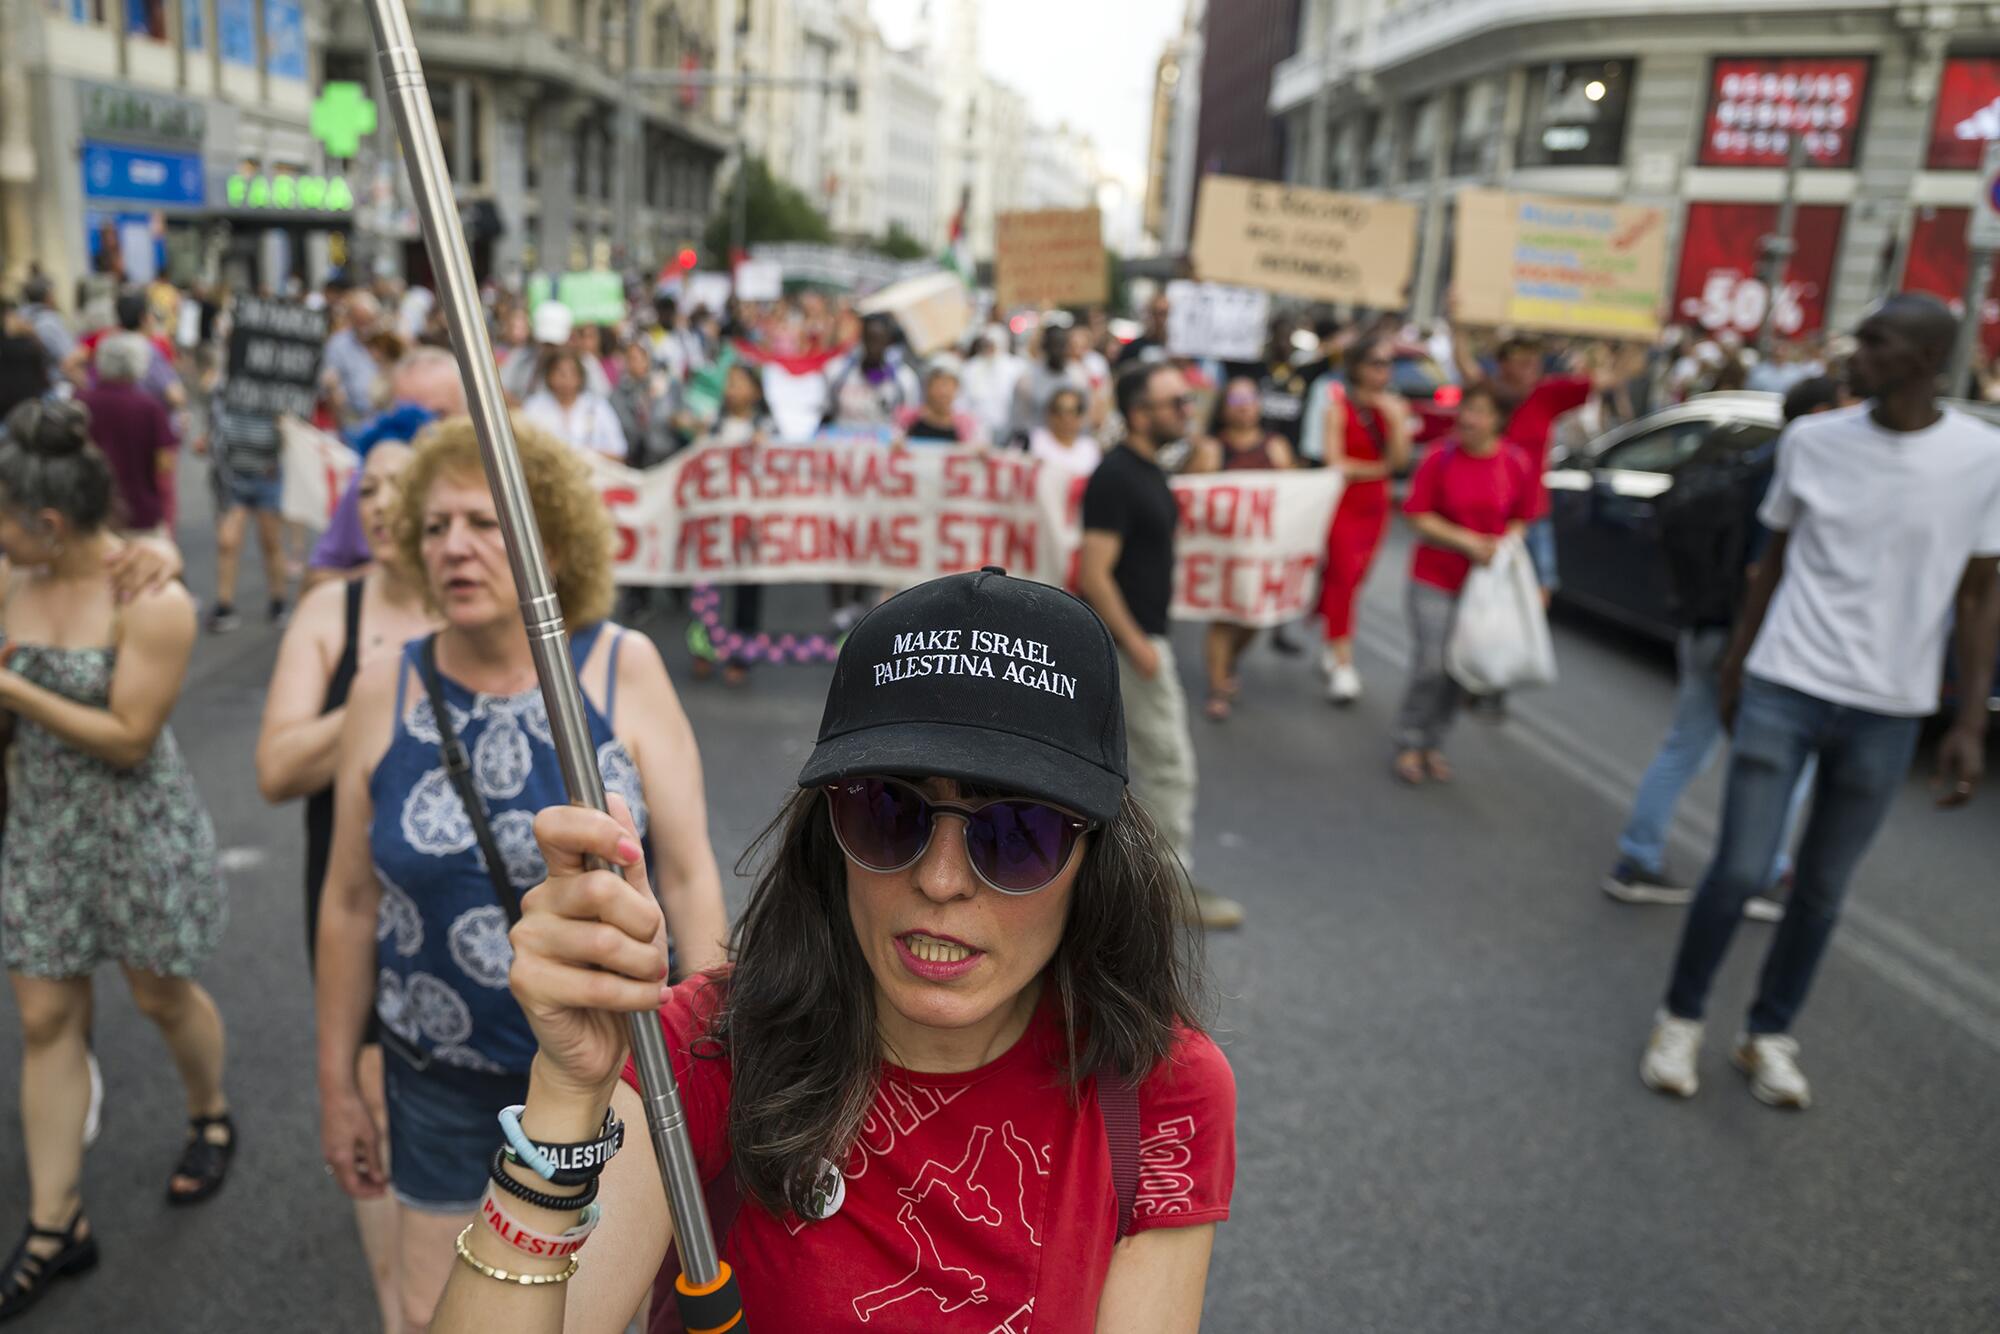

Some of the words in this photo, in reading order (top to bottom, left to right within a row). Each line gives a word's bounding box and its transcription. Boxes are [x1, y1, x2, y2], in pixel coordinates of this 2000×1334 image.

[226, 174, 353, 211] FARMA
[675, 442, 916, 506] PERSONAS
[942, 453, 1040, 500] SIN
[675, 513, 919, 572] PERSONAS
[937, 513, 1037, 573] SIN
[893, 630, 961, 655] MAKE
[971, 630, 1055, 666] ISRAEL
[874, 654, 995, 686] PALESTINA
[1002, 661, 1077, 699] AGAIN
[537, 1133, 619, 1169] PALESTINE
